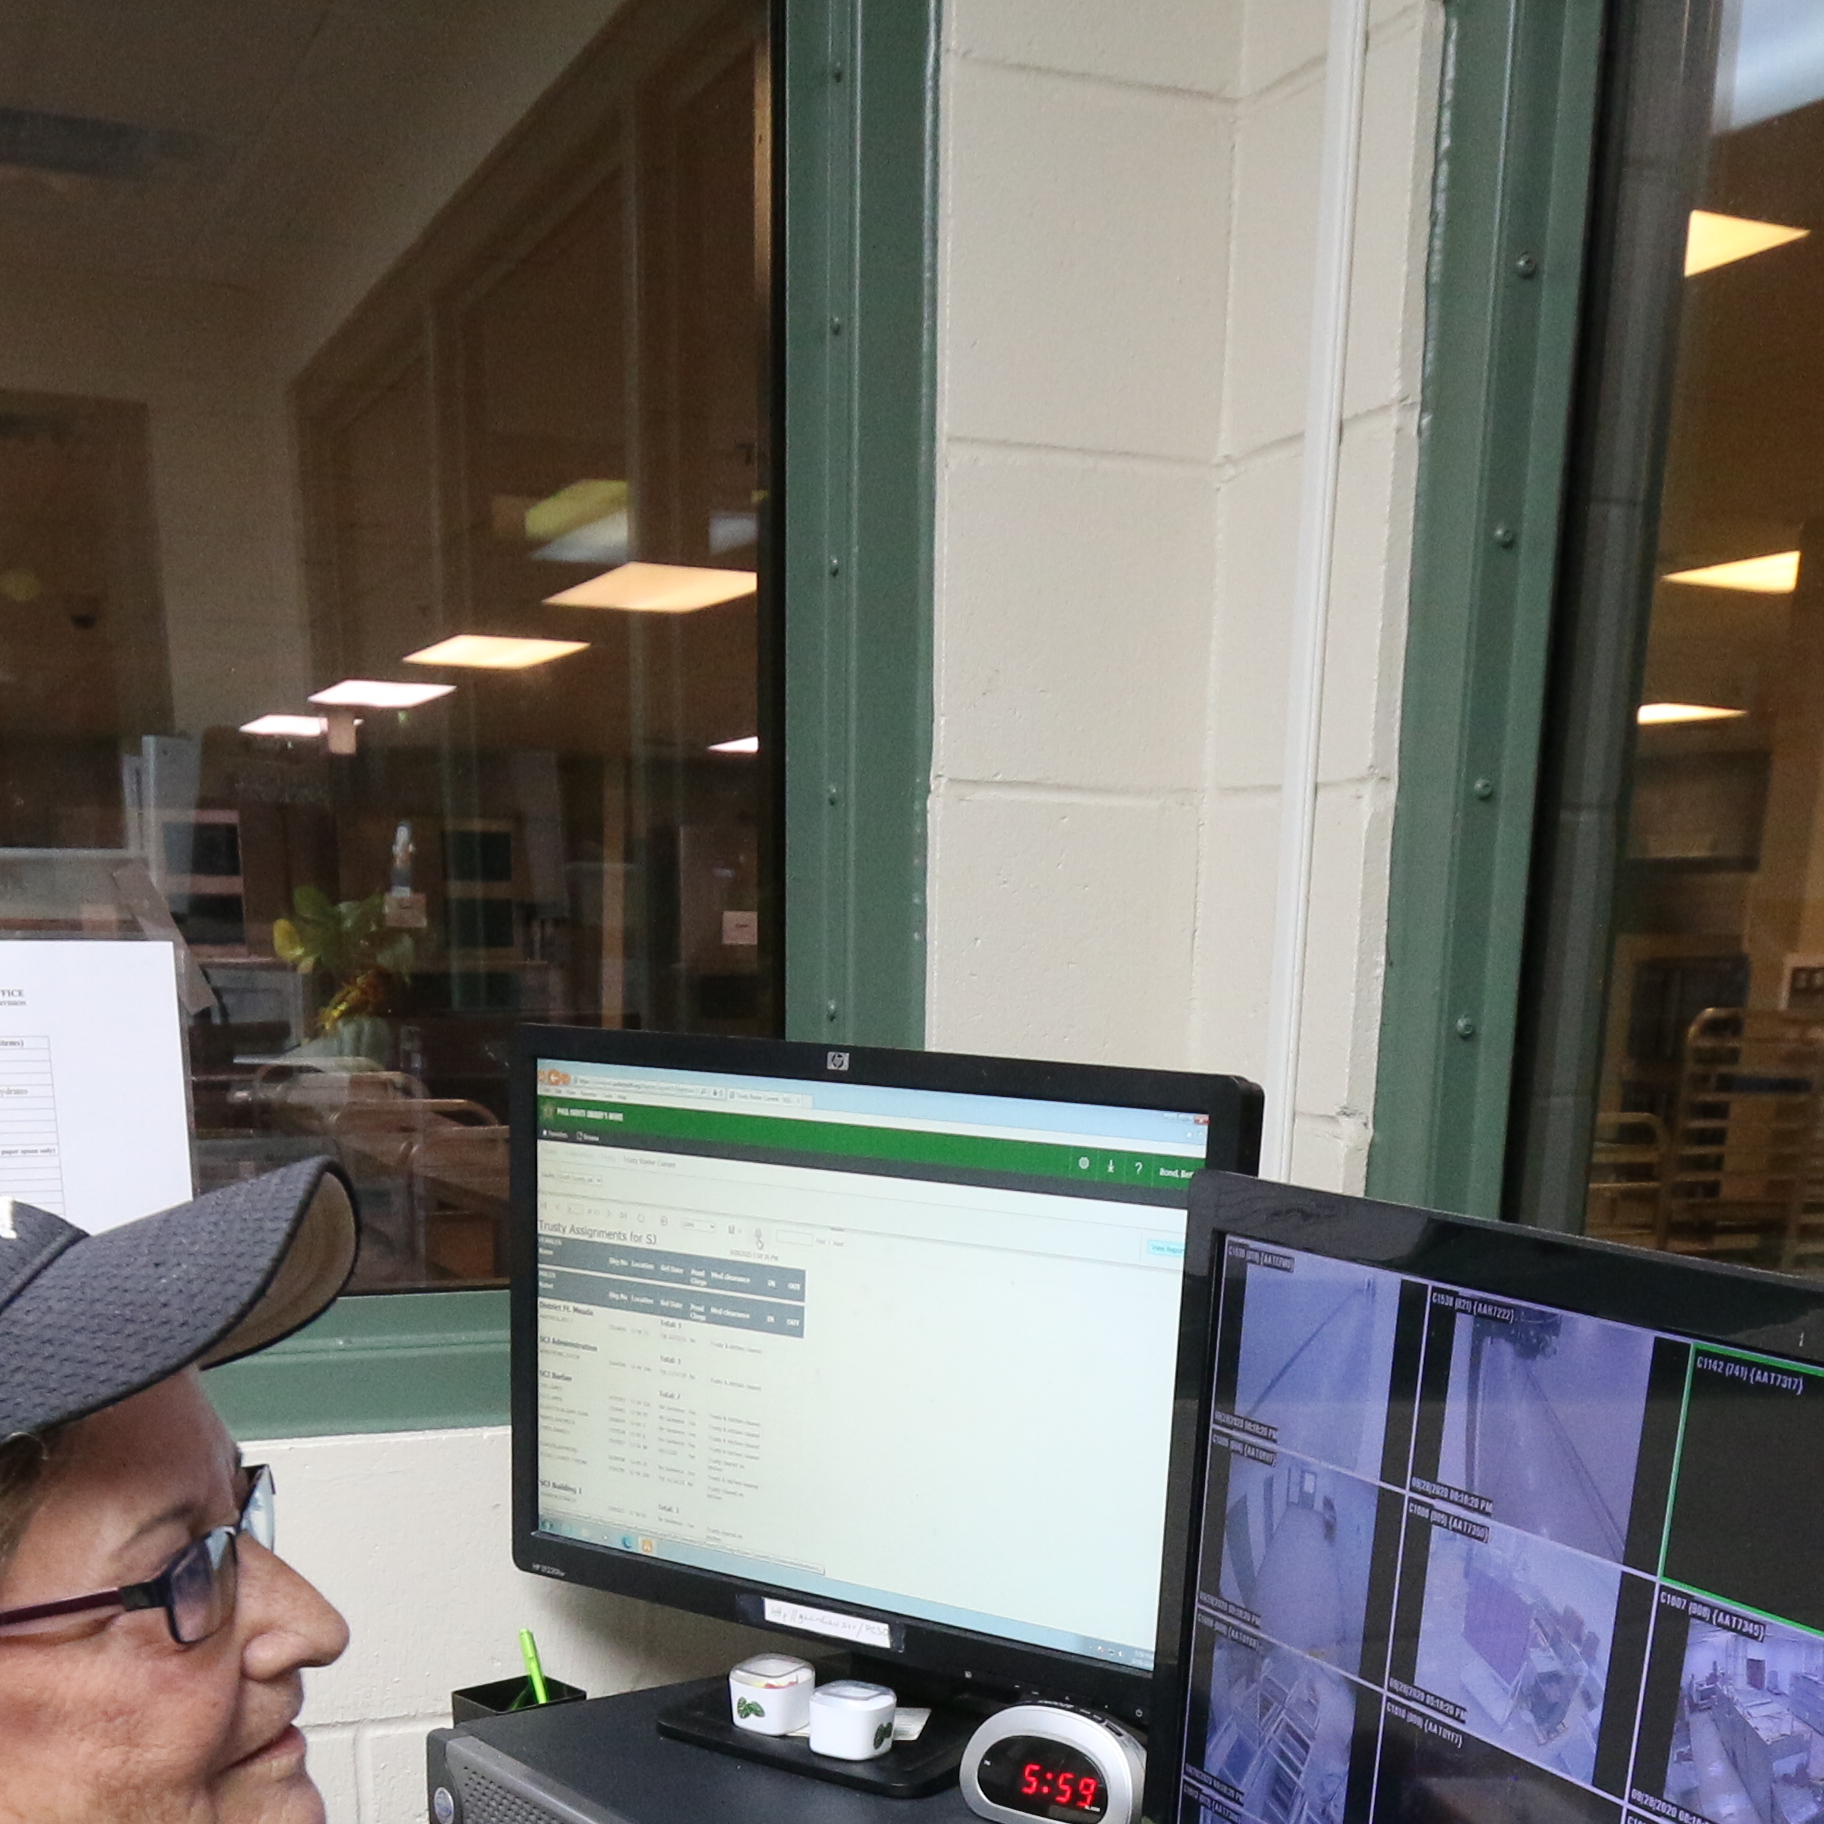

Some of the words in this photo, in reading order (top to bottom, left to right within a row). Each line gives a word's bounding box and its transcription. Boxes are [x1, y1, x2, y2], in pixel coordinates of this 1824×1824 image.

[538, 1219, 566, 1234] Trusty
[569, 1223, 627, 1242] Assignments
[629, 1230, 643, 1242] for
[631, 1259, 655, 1270] Location
[551, 1337, 598, 1352] Administration
[1697, 1356, 1724, 1373] C1142
[1725, 1362, 1748, 1381] (741)
[1749, 1367, 1804, 1395] {AAT7317}
[552, 1481, 577, 1495] Building
[1021, 1762, 1098, 1807] 5:59
